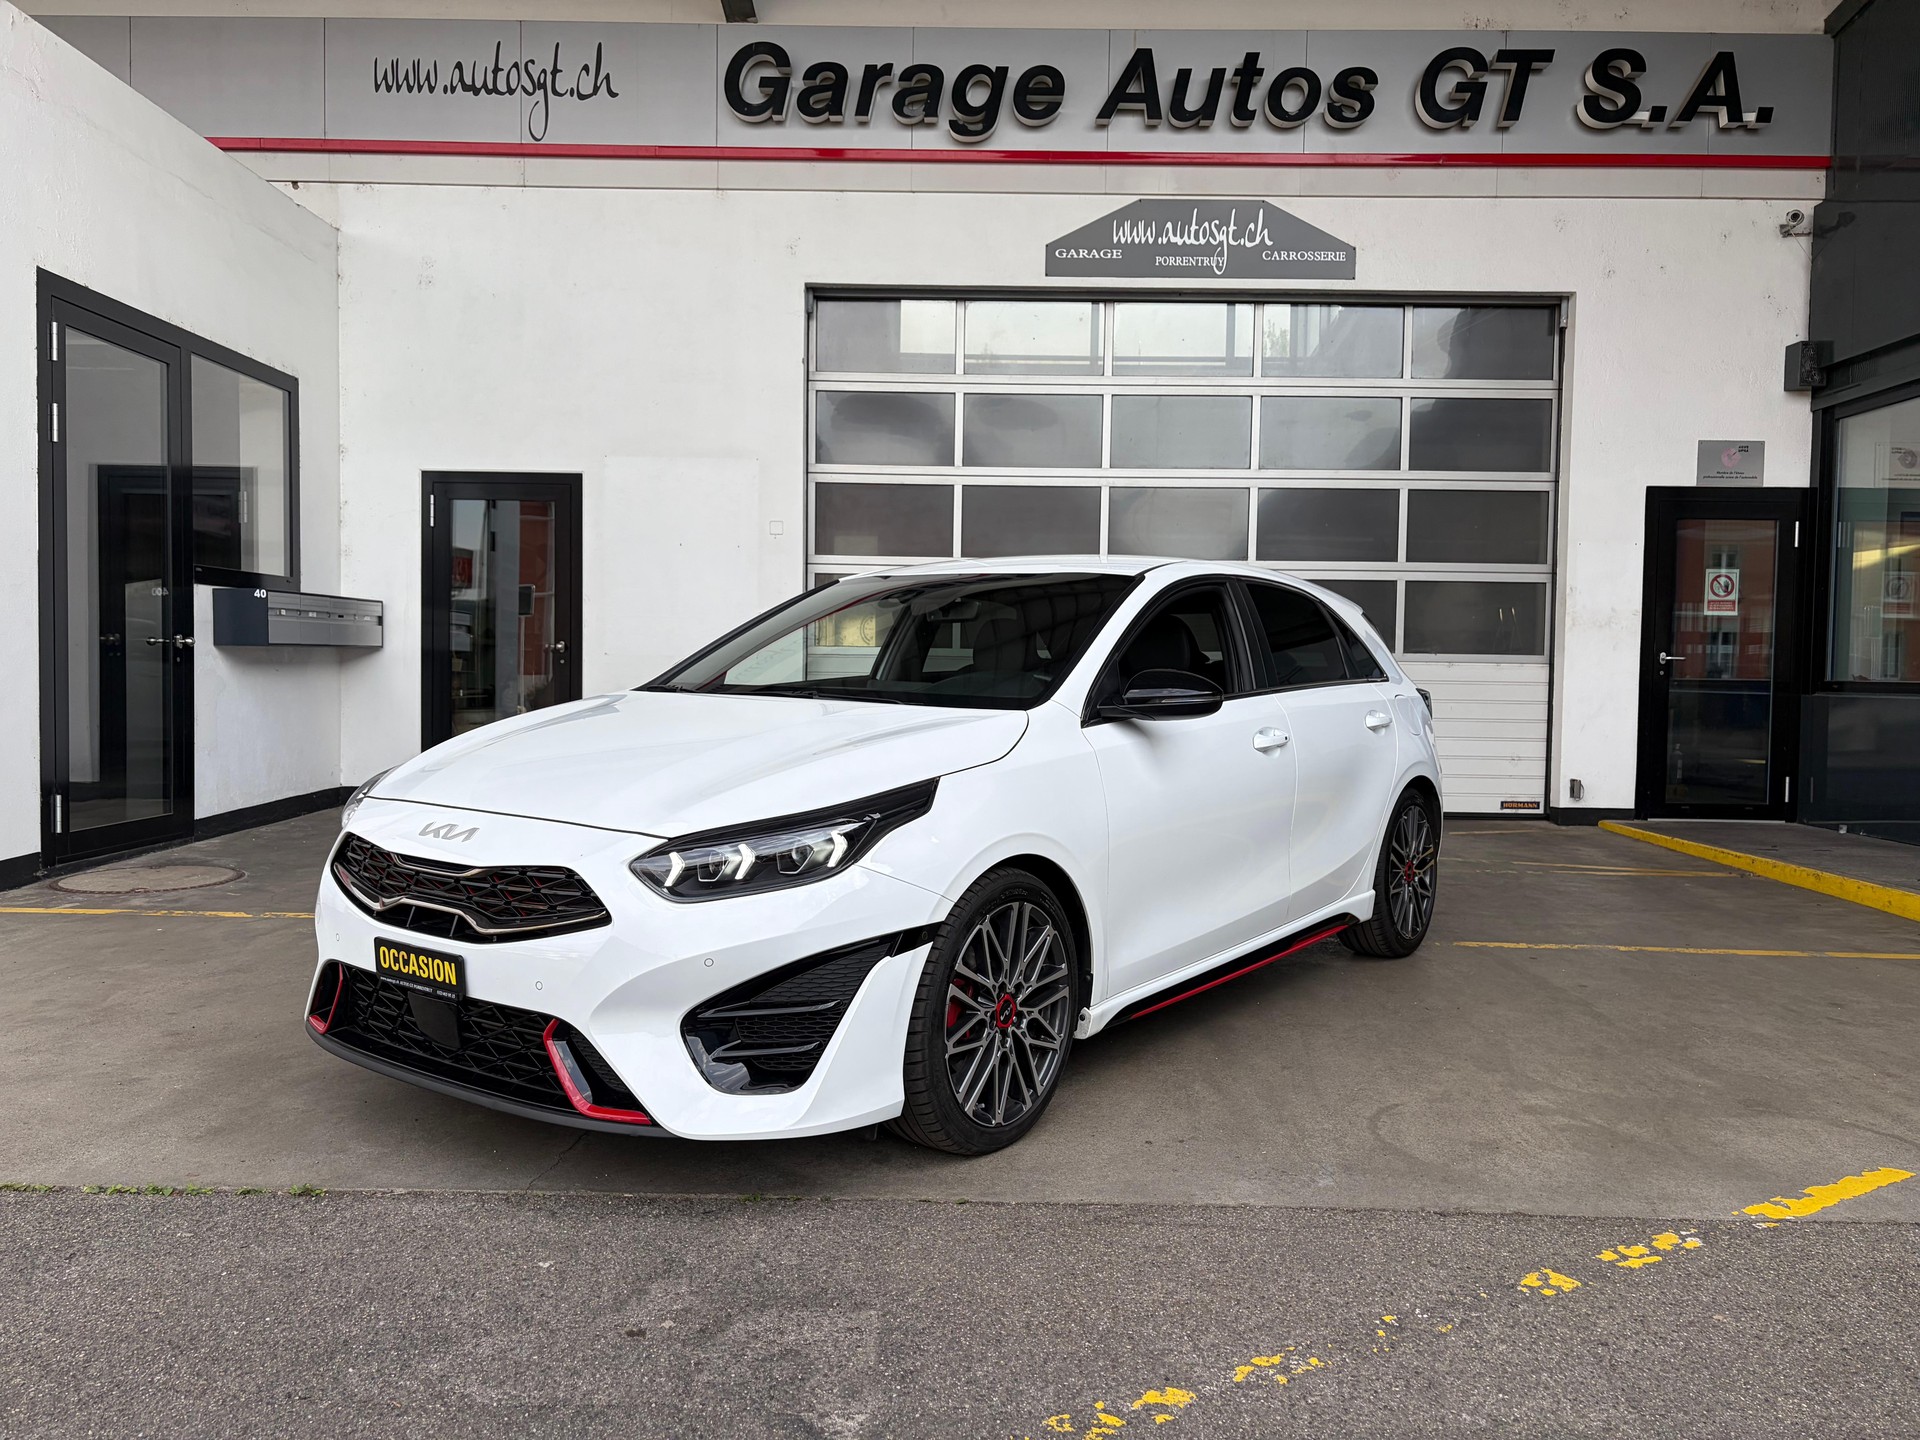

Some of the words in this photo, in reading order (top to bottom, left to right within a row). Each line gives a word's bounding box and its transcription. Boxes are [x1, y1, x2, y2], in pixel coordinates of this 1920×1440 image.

[374, 41, 619, 141] www.autosgt.ch
[724, 41, 1066, 143] Garage
[1095, 48, 1380, 129] Autos
[1415, 46, 1556, 129] GT
[1577, 48, 1774, 130] S.A.
[1112, 208, 1274, 275] www.autosgt.ch
[1055, 248, 1123, 259] GARAGE
[1155, 255, 1225, 267] PORRENTRUY
[1262, 250, 1347, 262] CARROSSERIE
[253, 589, 267, 598] 40
[418, 821, 480, 843] KIA
[380, 946, 457, 985] OCCASION
